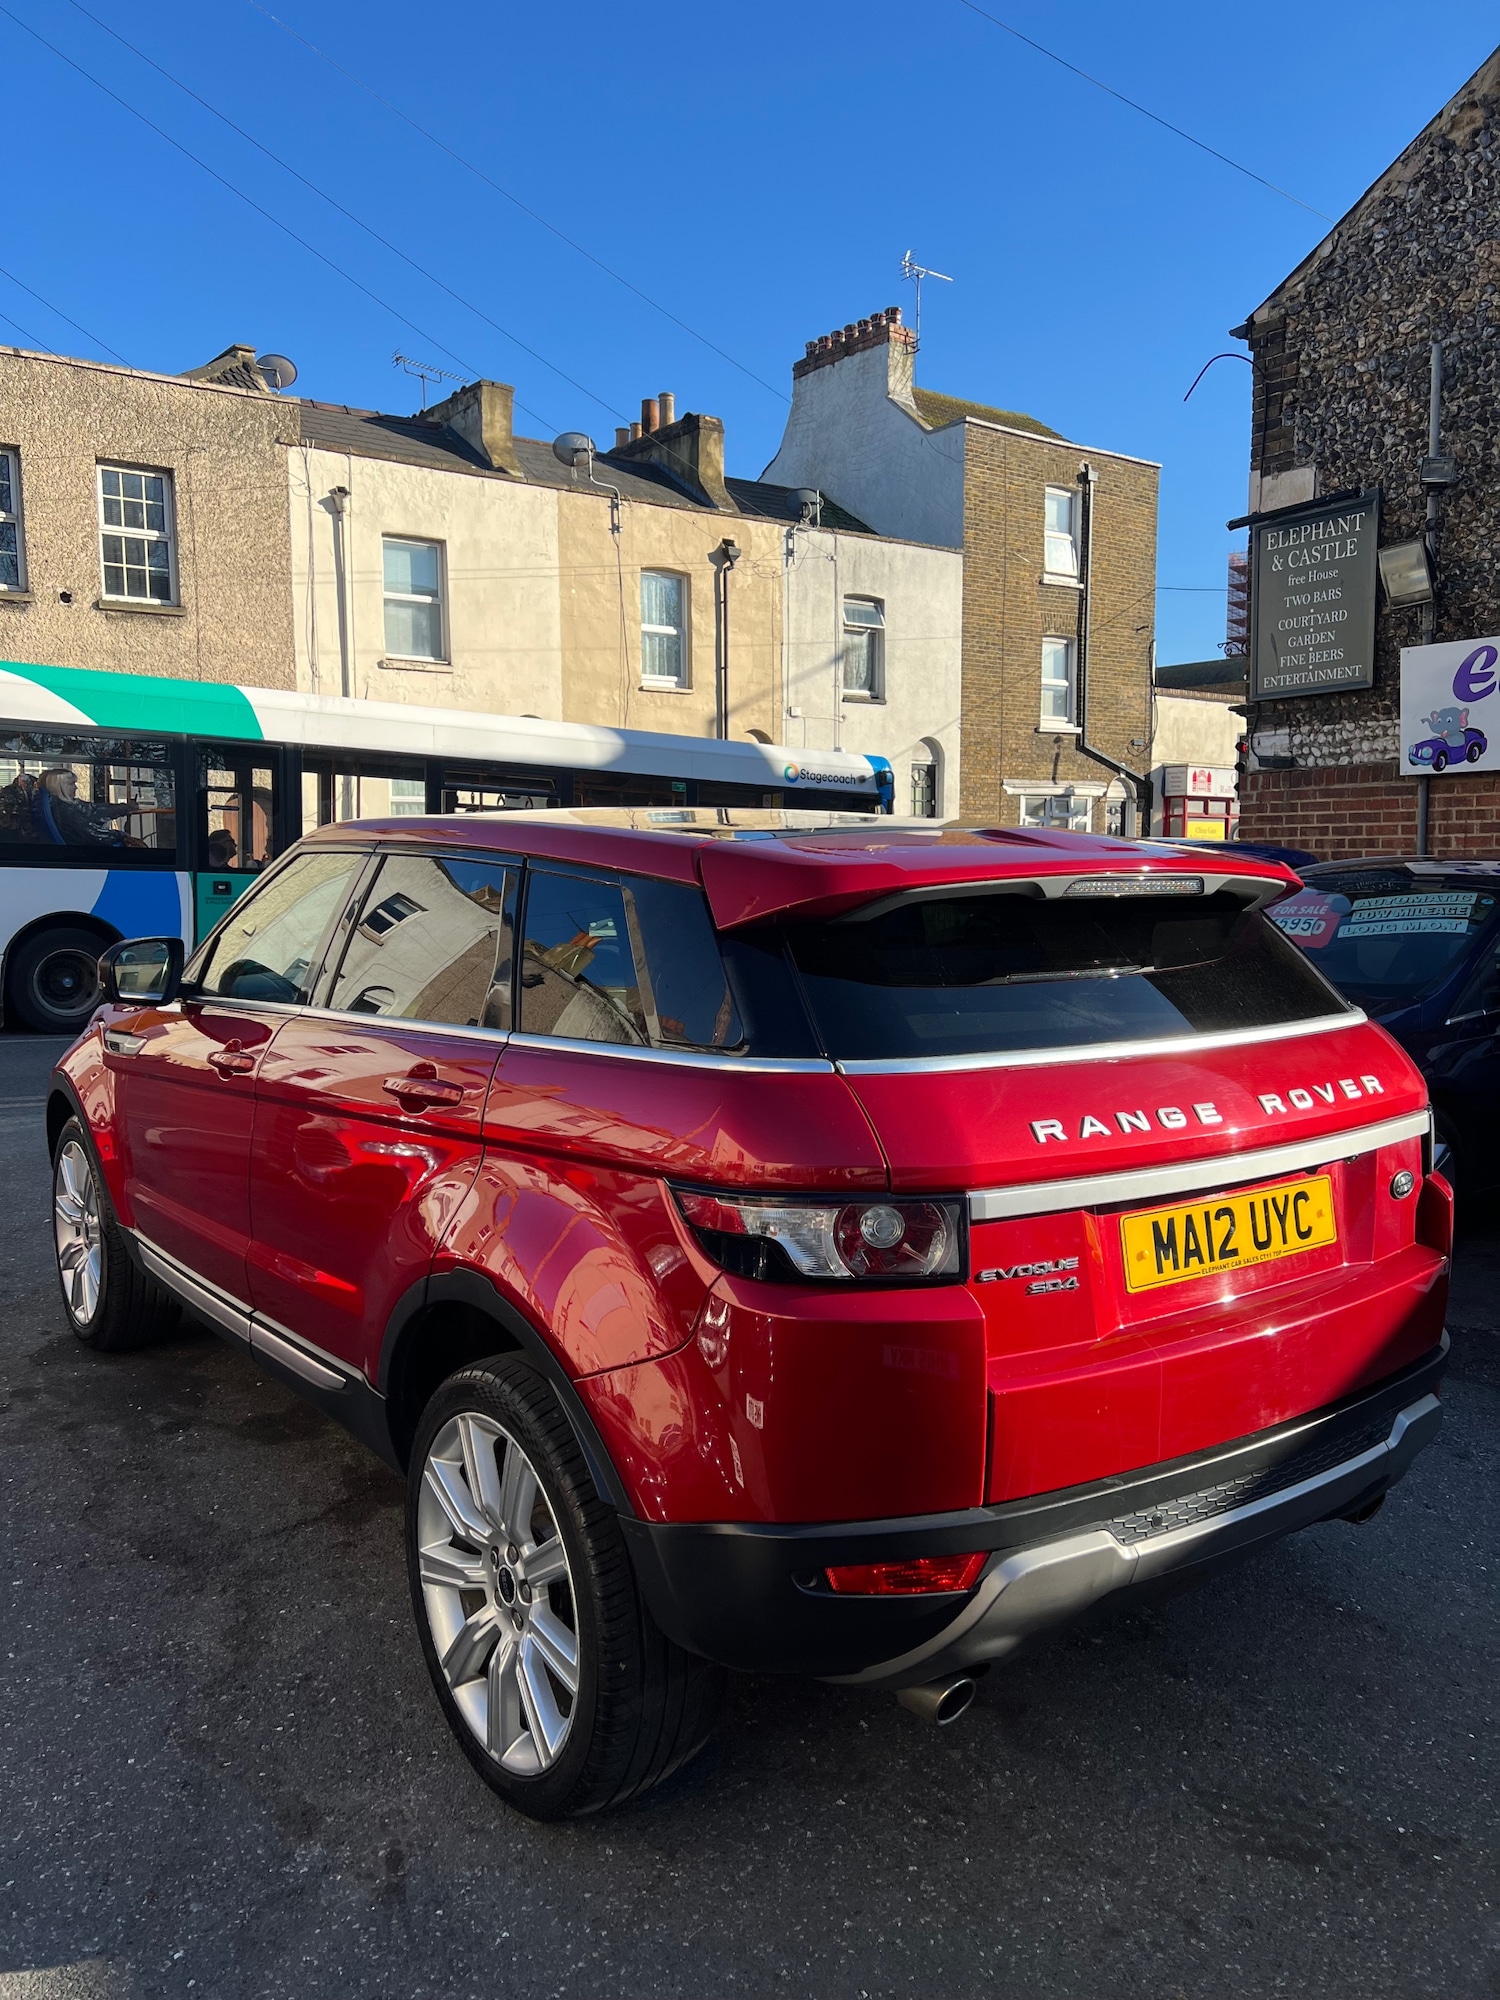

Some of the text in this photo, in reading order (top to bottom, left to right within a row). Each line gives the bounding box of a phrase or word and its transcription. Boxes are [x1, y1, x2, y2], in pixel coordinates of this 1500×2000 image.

[1266, 512, 1366, 551] ELEPHANT
[1271, 538, 1358, 572] & CASTLE
[1288, 568, 1339, 586] free House
[1283, 587, 1342, 608] TWO BARS
[1278, 609, 1348, 631] COURTYARD
[1287, 630, 1336, 648] GARDEN
[1280, 648, 1344, 668] FINE BEERS
[1263, 664, 1363, 688] ENTERTAINMENT
[800, 768, 856, 785] Stagecoach
[1272, 905, 1329, 915] FOR SALE
[1356, 894, 1473, 908] AUTOMATIC
[1355, 906, 1468, 921] LOW MILEAGE
[1274, 918, 1314, 932] 595
[1342, 922, 1397, 936] LONG
[1030, 1074, 1385, 1144] RANGE ROVER
[1152, 1190, 1313, 1275] MA12 UYC
[978, 1256, 1079, 1283] EVOQUE
[1201, 1261, 1230, 1275] ELEPHANT
[1231, 1259, 1242, 1268] CAR
[1243, 1256, 1259, 1265] SALES
[1260, 1252, 1272, 1260] CT11
[1028, 1276, 1080, 1294] SD4
